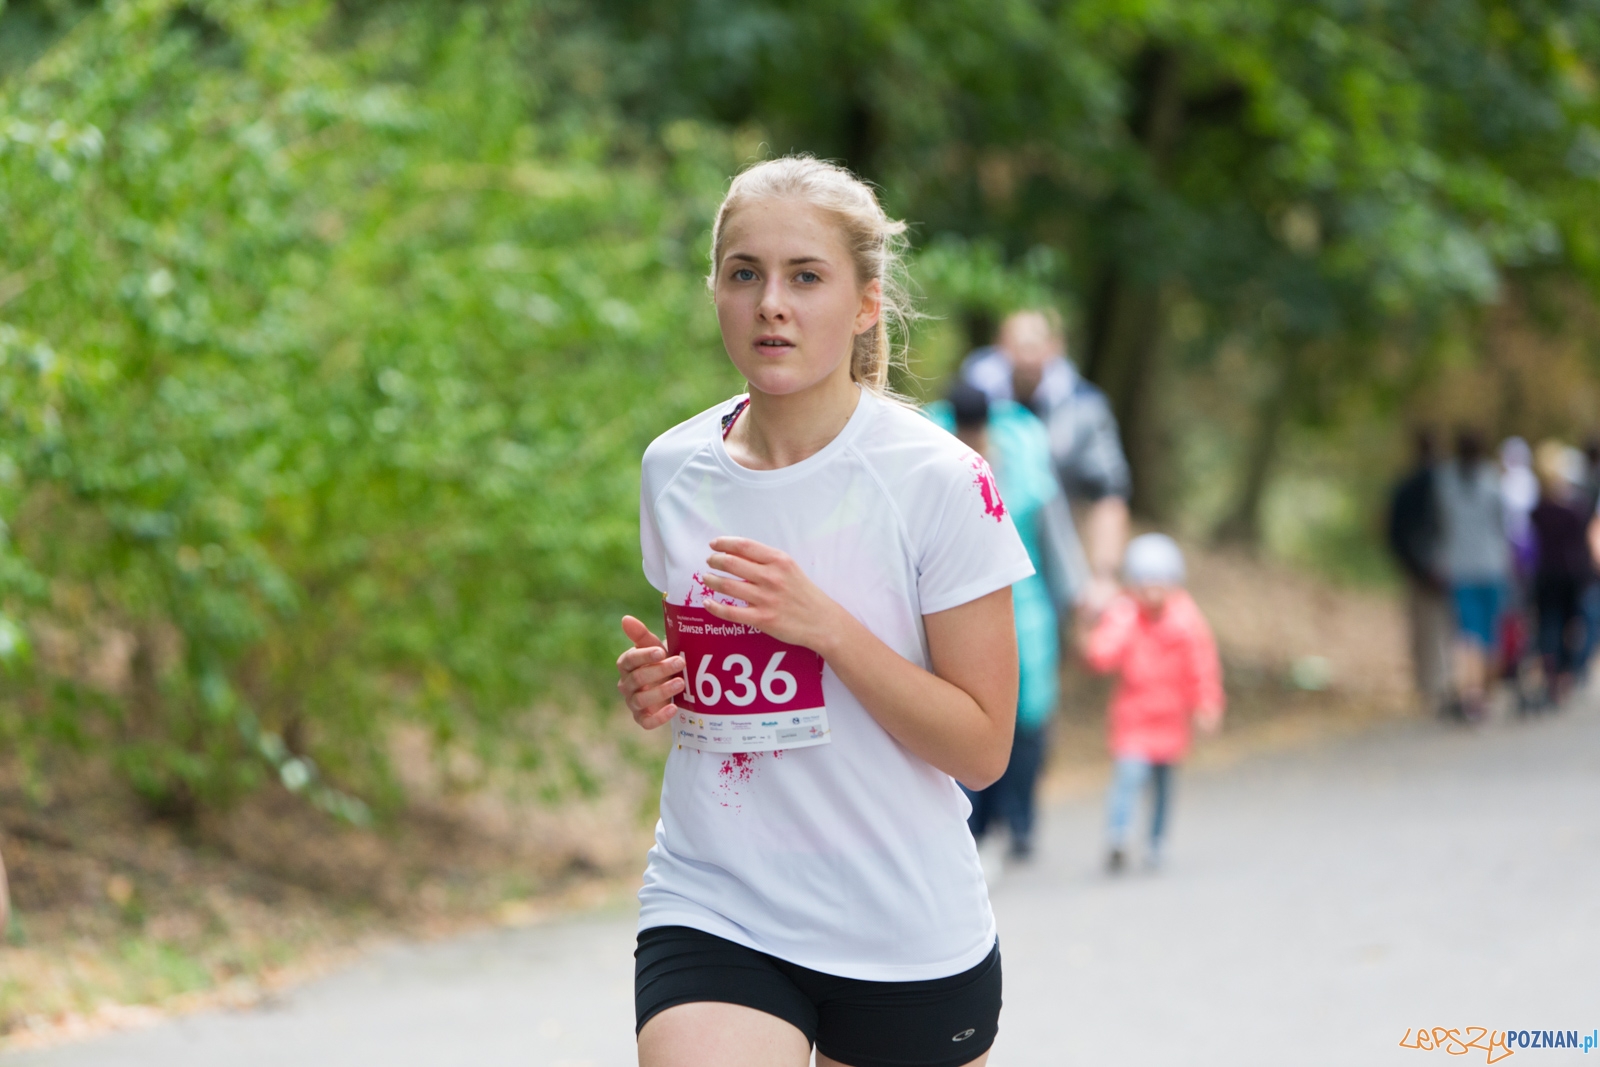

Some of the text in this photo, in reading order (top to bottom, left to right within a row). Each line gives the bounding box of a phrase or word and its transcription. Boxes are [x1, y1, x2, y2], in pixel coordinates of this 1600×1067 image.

[678, 622, 704, 634] Zawsze
[704, 623, 745, 636] Pier(w)si
[679, 651, 798, 707] 1636
